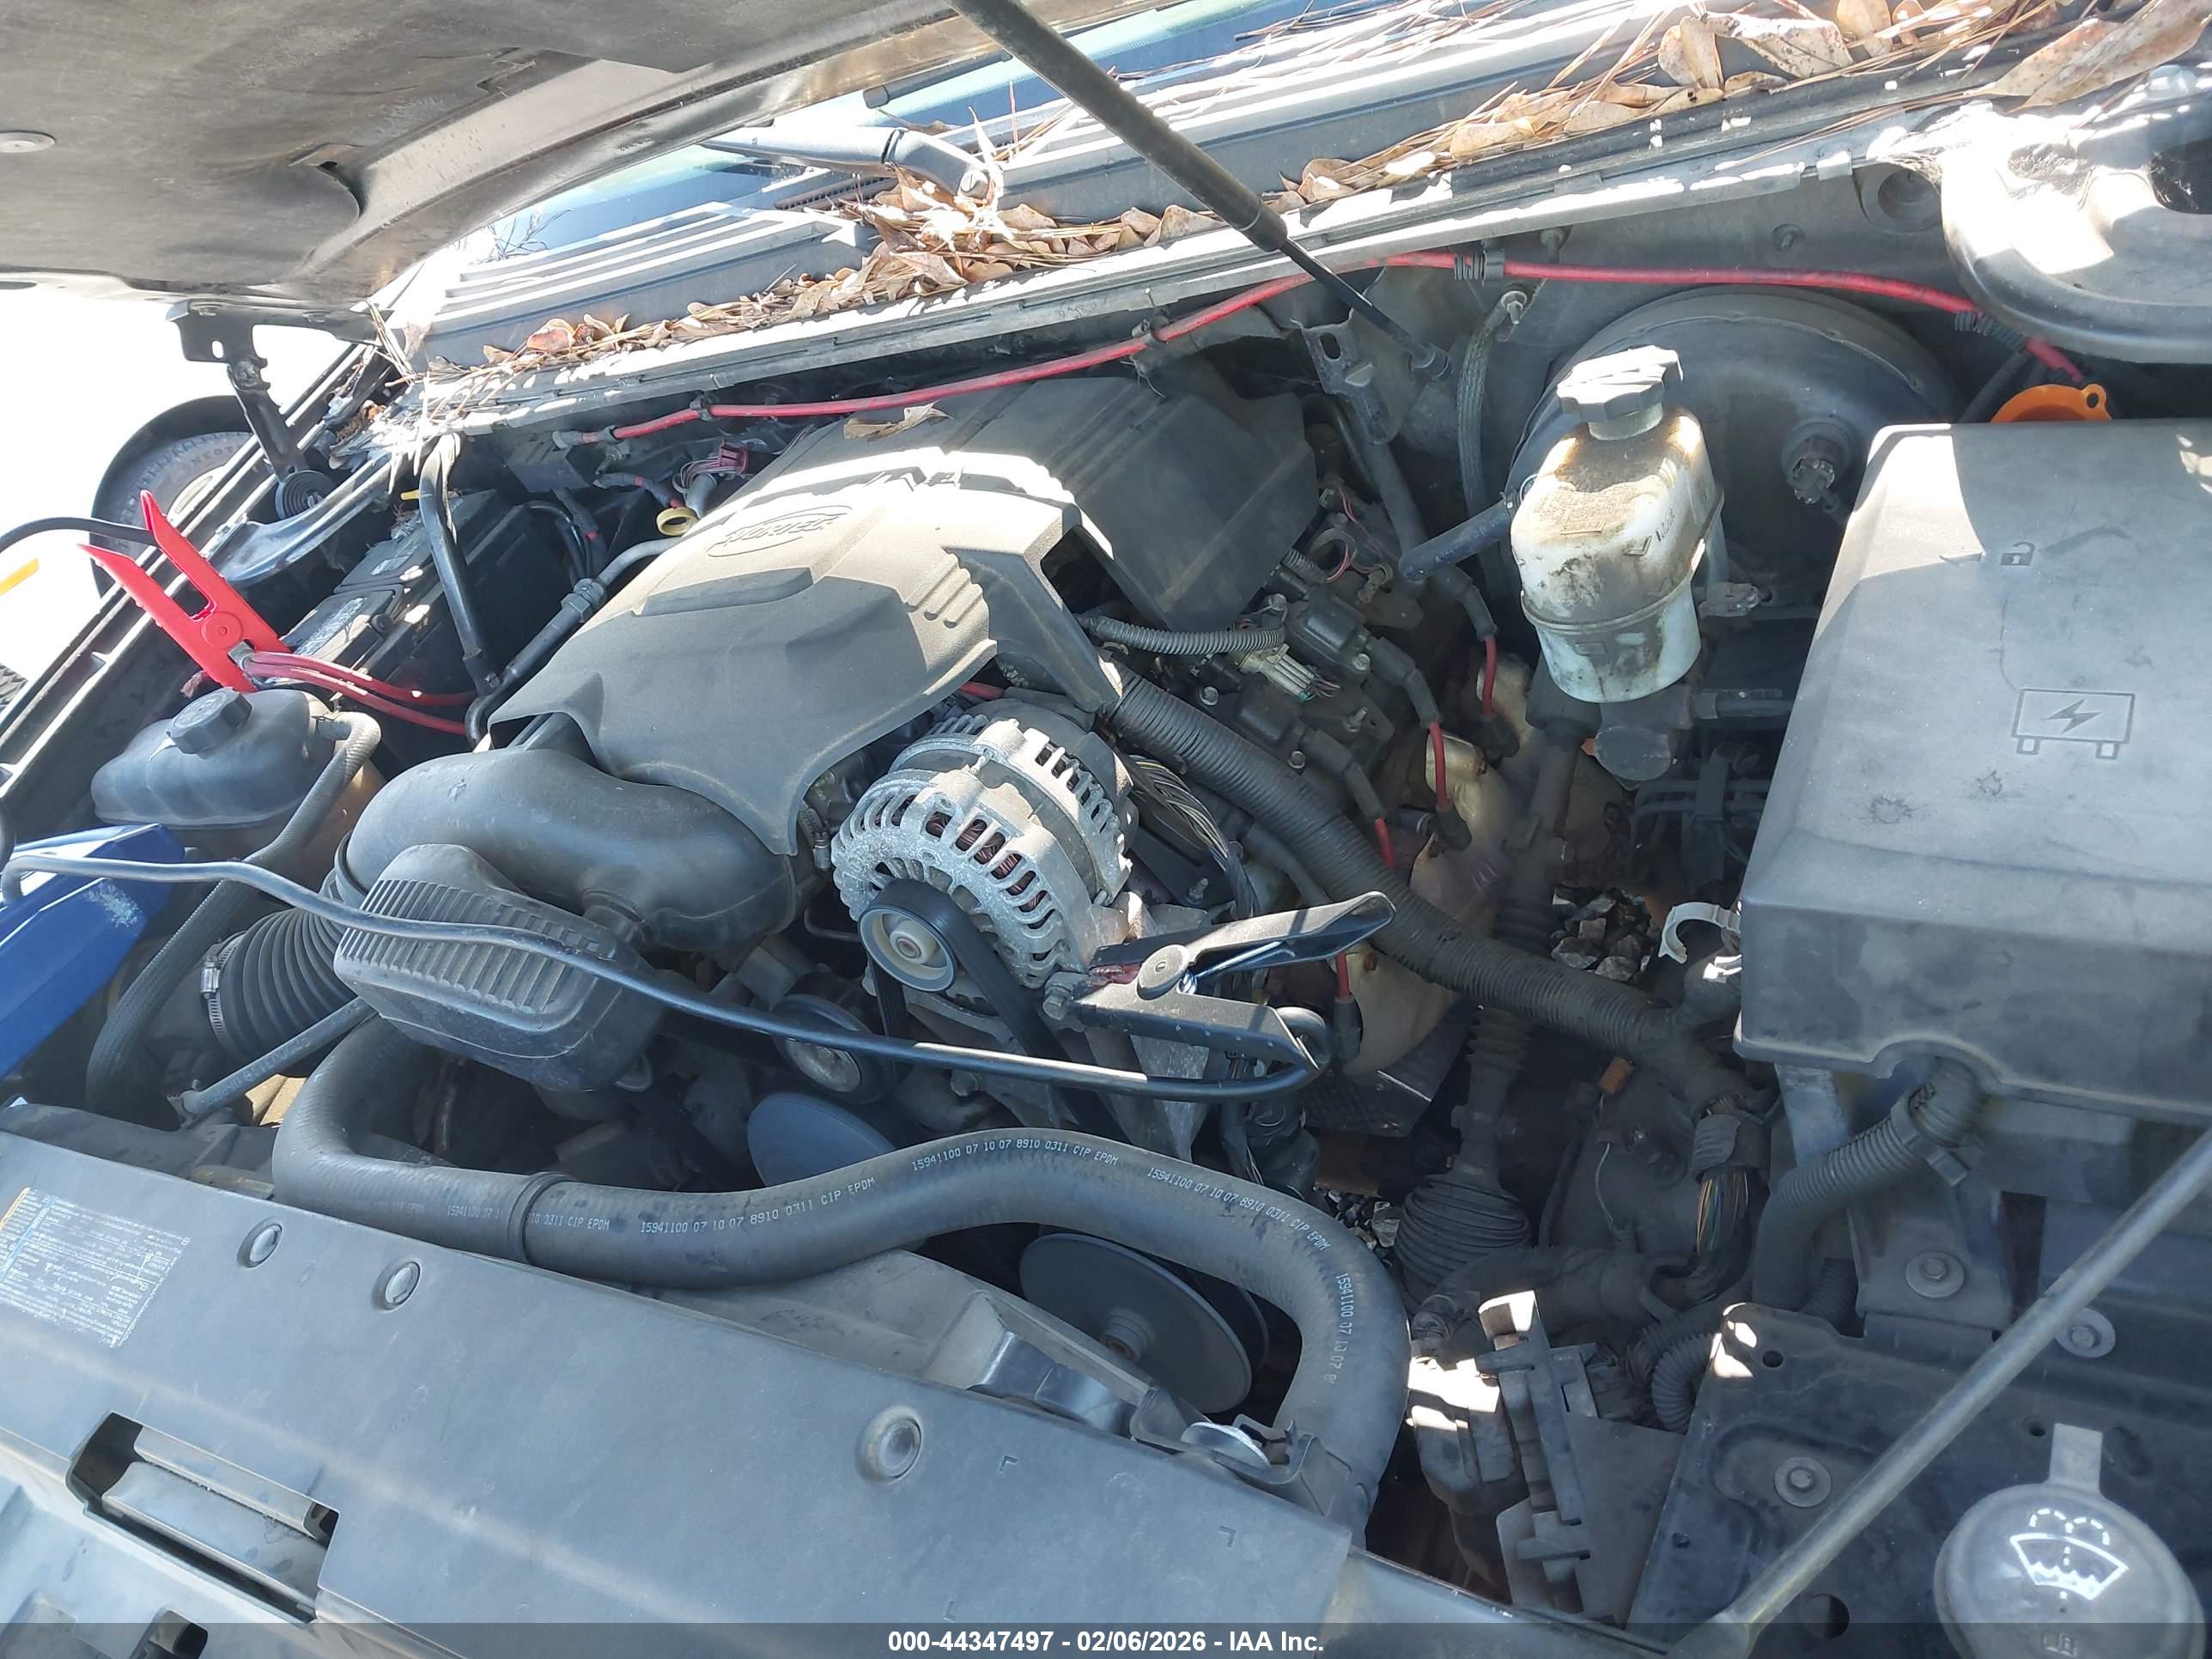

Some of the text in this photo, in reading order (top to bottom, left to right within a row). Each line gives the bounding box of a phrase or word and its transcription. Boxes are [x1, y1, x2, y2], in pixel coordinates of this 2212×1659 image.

[912, 1139, 1119, 1172] 15941100 07 10 07 8910 0311 CIP EPDM
[640, 1220, 689, 1234] 15941100
[713, 1219, 726, 1231] 10
[729, 1218, 744, 1229] 07
[750, 1209, 779, 1225] 8910
[785, 1199, 813, 1217] 0311
[820, 1188, 842, 1206] CIP
[847, 1176, 876, 1196] EPDM
[1146, 1167, 1332, 1252] 15941100 07 10 07 8910 0311 CIP EPDM
[568, 1215, 584, 1229] CIP
[586, 1217, 611, 1231] EPDM
[1335, 1273, 1355, 1318] 15941100
[1339, 1322, 1353, 1335] 07
[1328, 1355, 1346, 1369] 07
